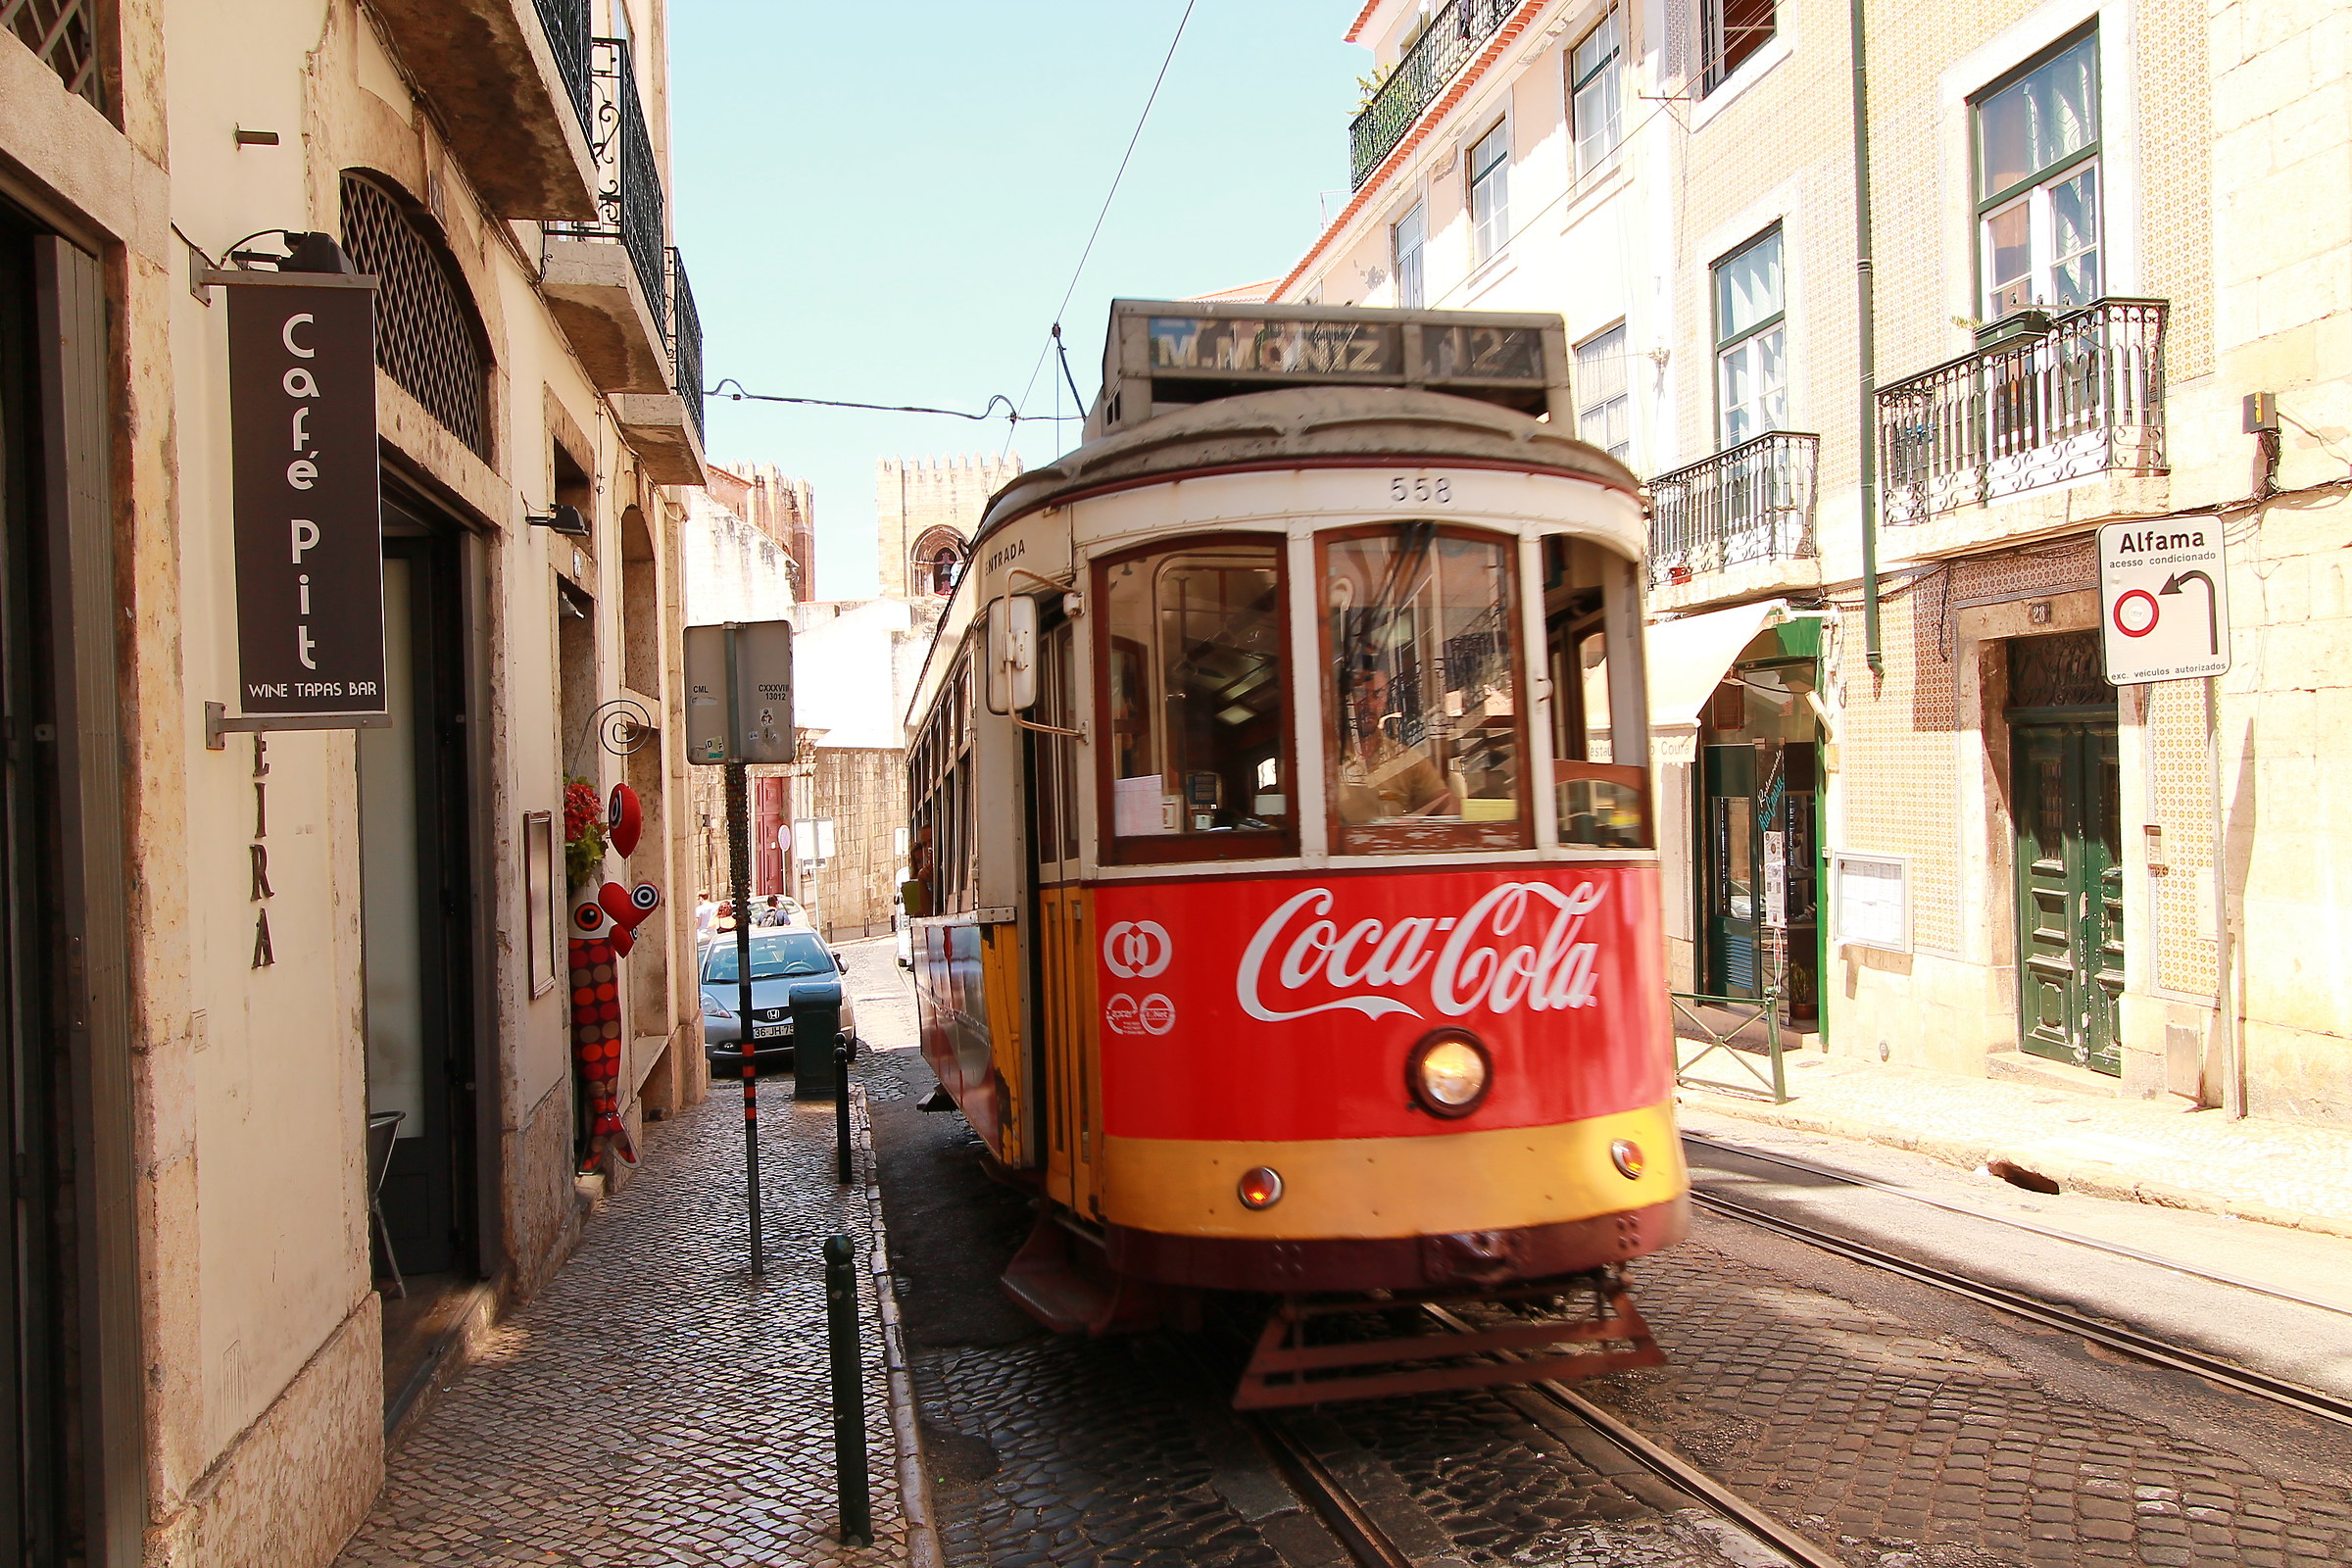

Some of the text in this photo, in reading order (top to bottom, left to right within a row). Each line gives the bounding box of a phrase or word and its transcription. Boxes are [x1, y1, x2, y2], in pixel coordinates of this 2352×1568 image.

[1445, 327, 1506, 371] 12
[282, 313, 320, 671] Café Pit
[1391, 476, 1452, 503] 558
[2119, 530, 2205, 554] Alfama
[985, 539, 1026, 576] ENTRADA
[2109, 551, 2217, 568] acesso condicionado
[2034, 605, 2045, 622] 28
[2175, 662, 2226, 674] autorizados
[248, 681, 377, 698] WINE TAPAS BAR
[693, 685, 709, 694] CML
[765, 692, 786, 701] 13012
[1661, 741, 1690, 756] Coura
[1237, 881, 1610, 1022] Coca-Cola
